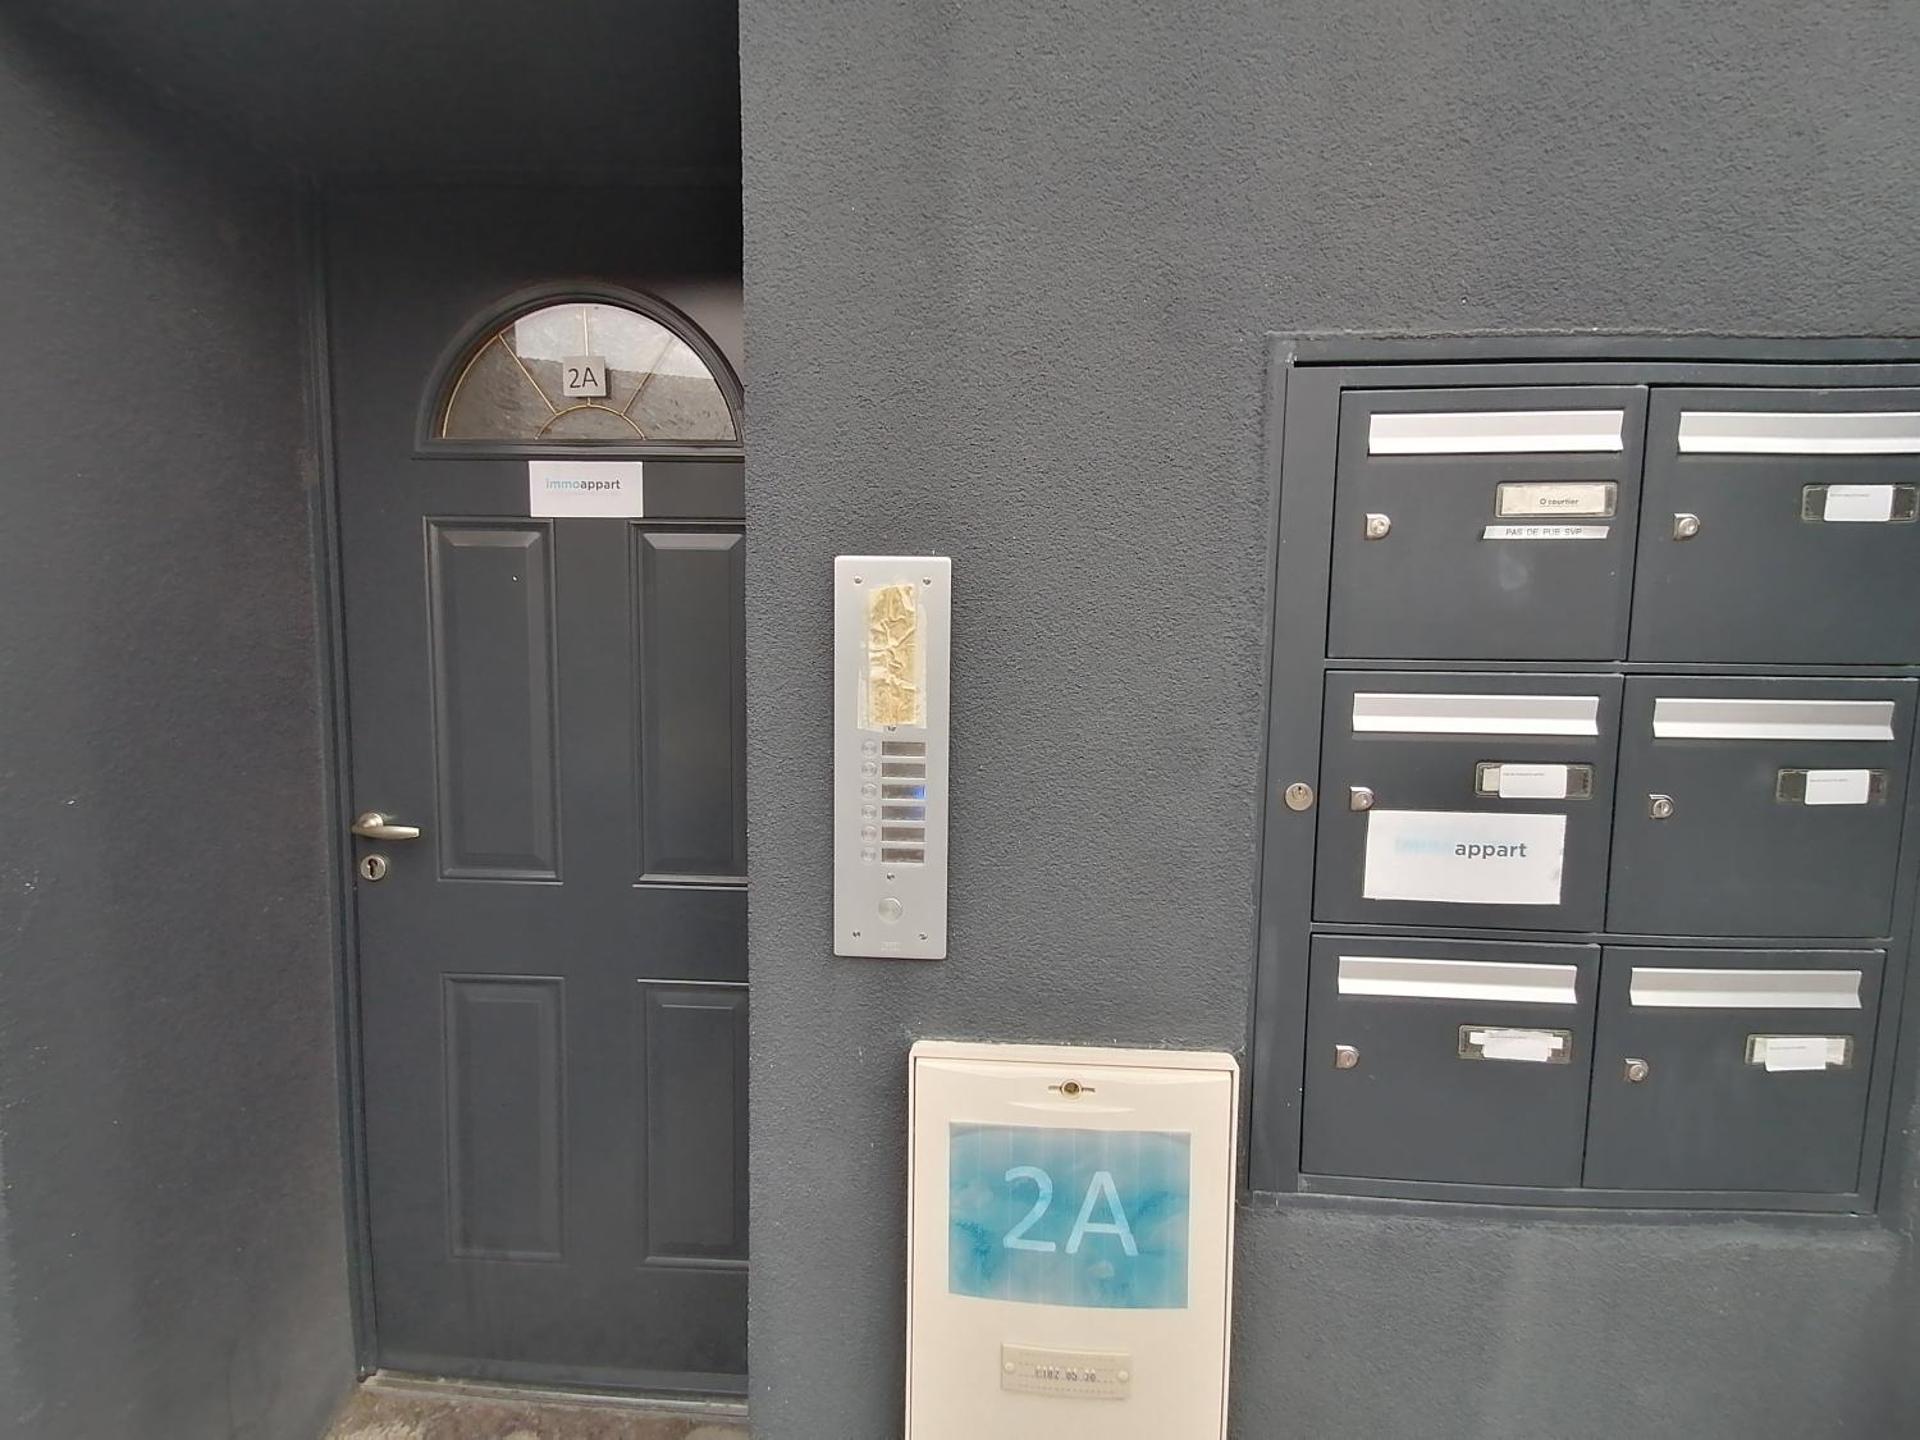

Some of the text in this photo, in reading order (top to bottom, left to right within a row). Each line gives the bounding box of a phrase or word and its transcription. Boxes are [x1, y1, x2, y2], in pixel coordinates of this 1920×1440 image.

[568, 366, 598, 389] 2A
[546, 478, 621, 491] immoappart
[1505, 528, 1583, 536] PAS DE PUB SVP
[1003, 1166, 1140, 1257] 2A
